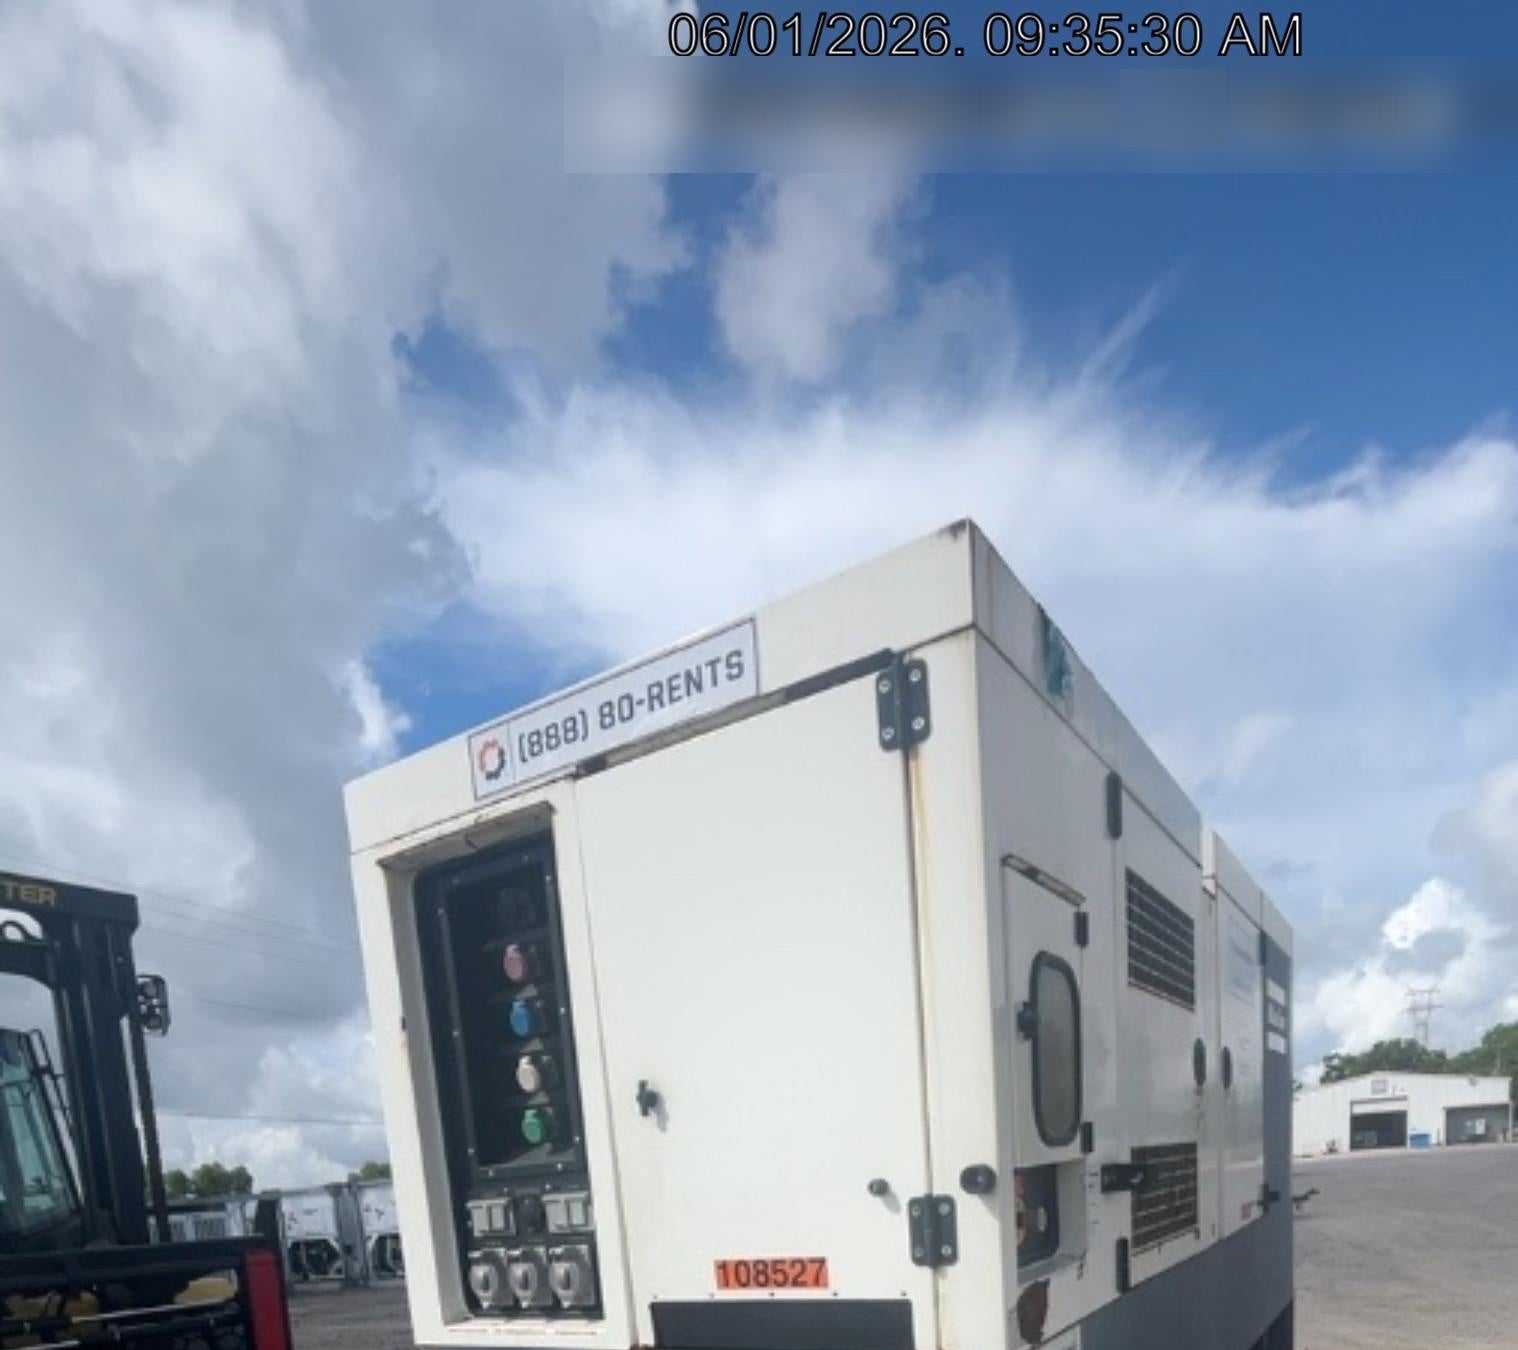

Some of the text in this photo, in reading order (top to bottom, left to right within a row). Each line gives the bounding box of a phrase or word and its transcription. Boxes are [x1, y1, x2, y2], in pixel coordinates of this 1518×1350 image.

[519, 649, 744, 763] (888) 80-RENTS
[716, 1257, 826, 1288] 108527
